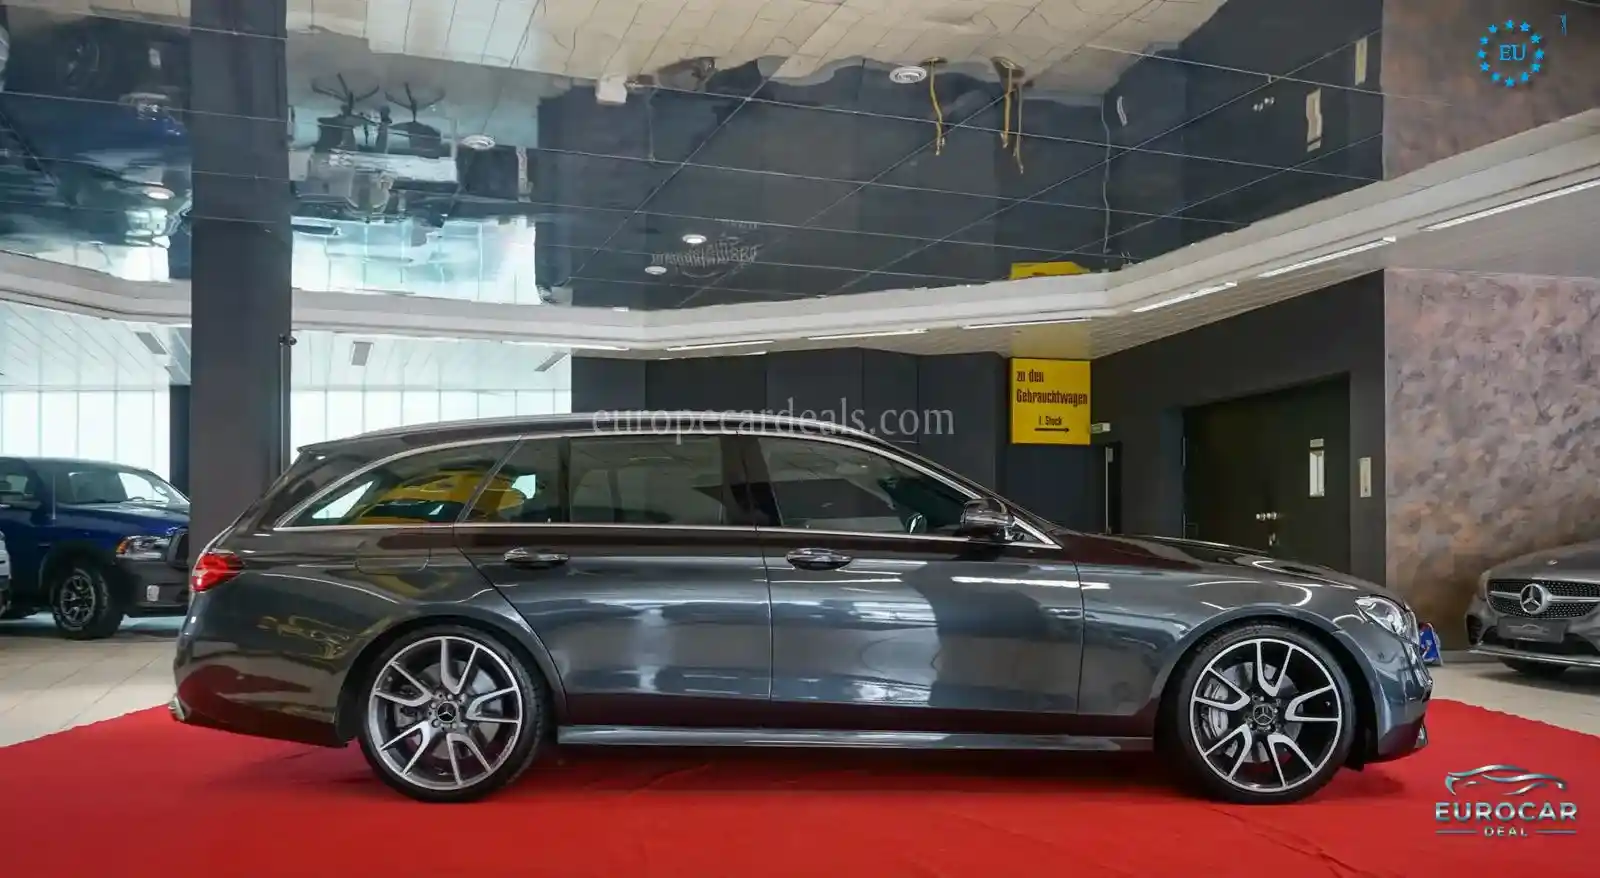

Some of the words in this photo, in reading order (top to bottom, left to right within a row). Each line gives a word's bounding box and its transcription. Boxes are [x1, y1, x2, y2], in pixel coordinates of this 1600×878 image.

[1016, 371, 1026, 382] zu
[1029, 369, 1044, 382] den
[1016, 389, 1088, 407] Gebrauchtwagen
